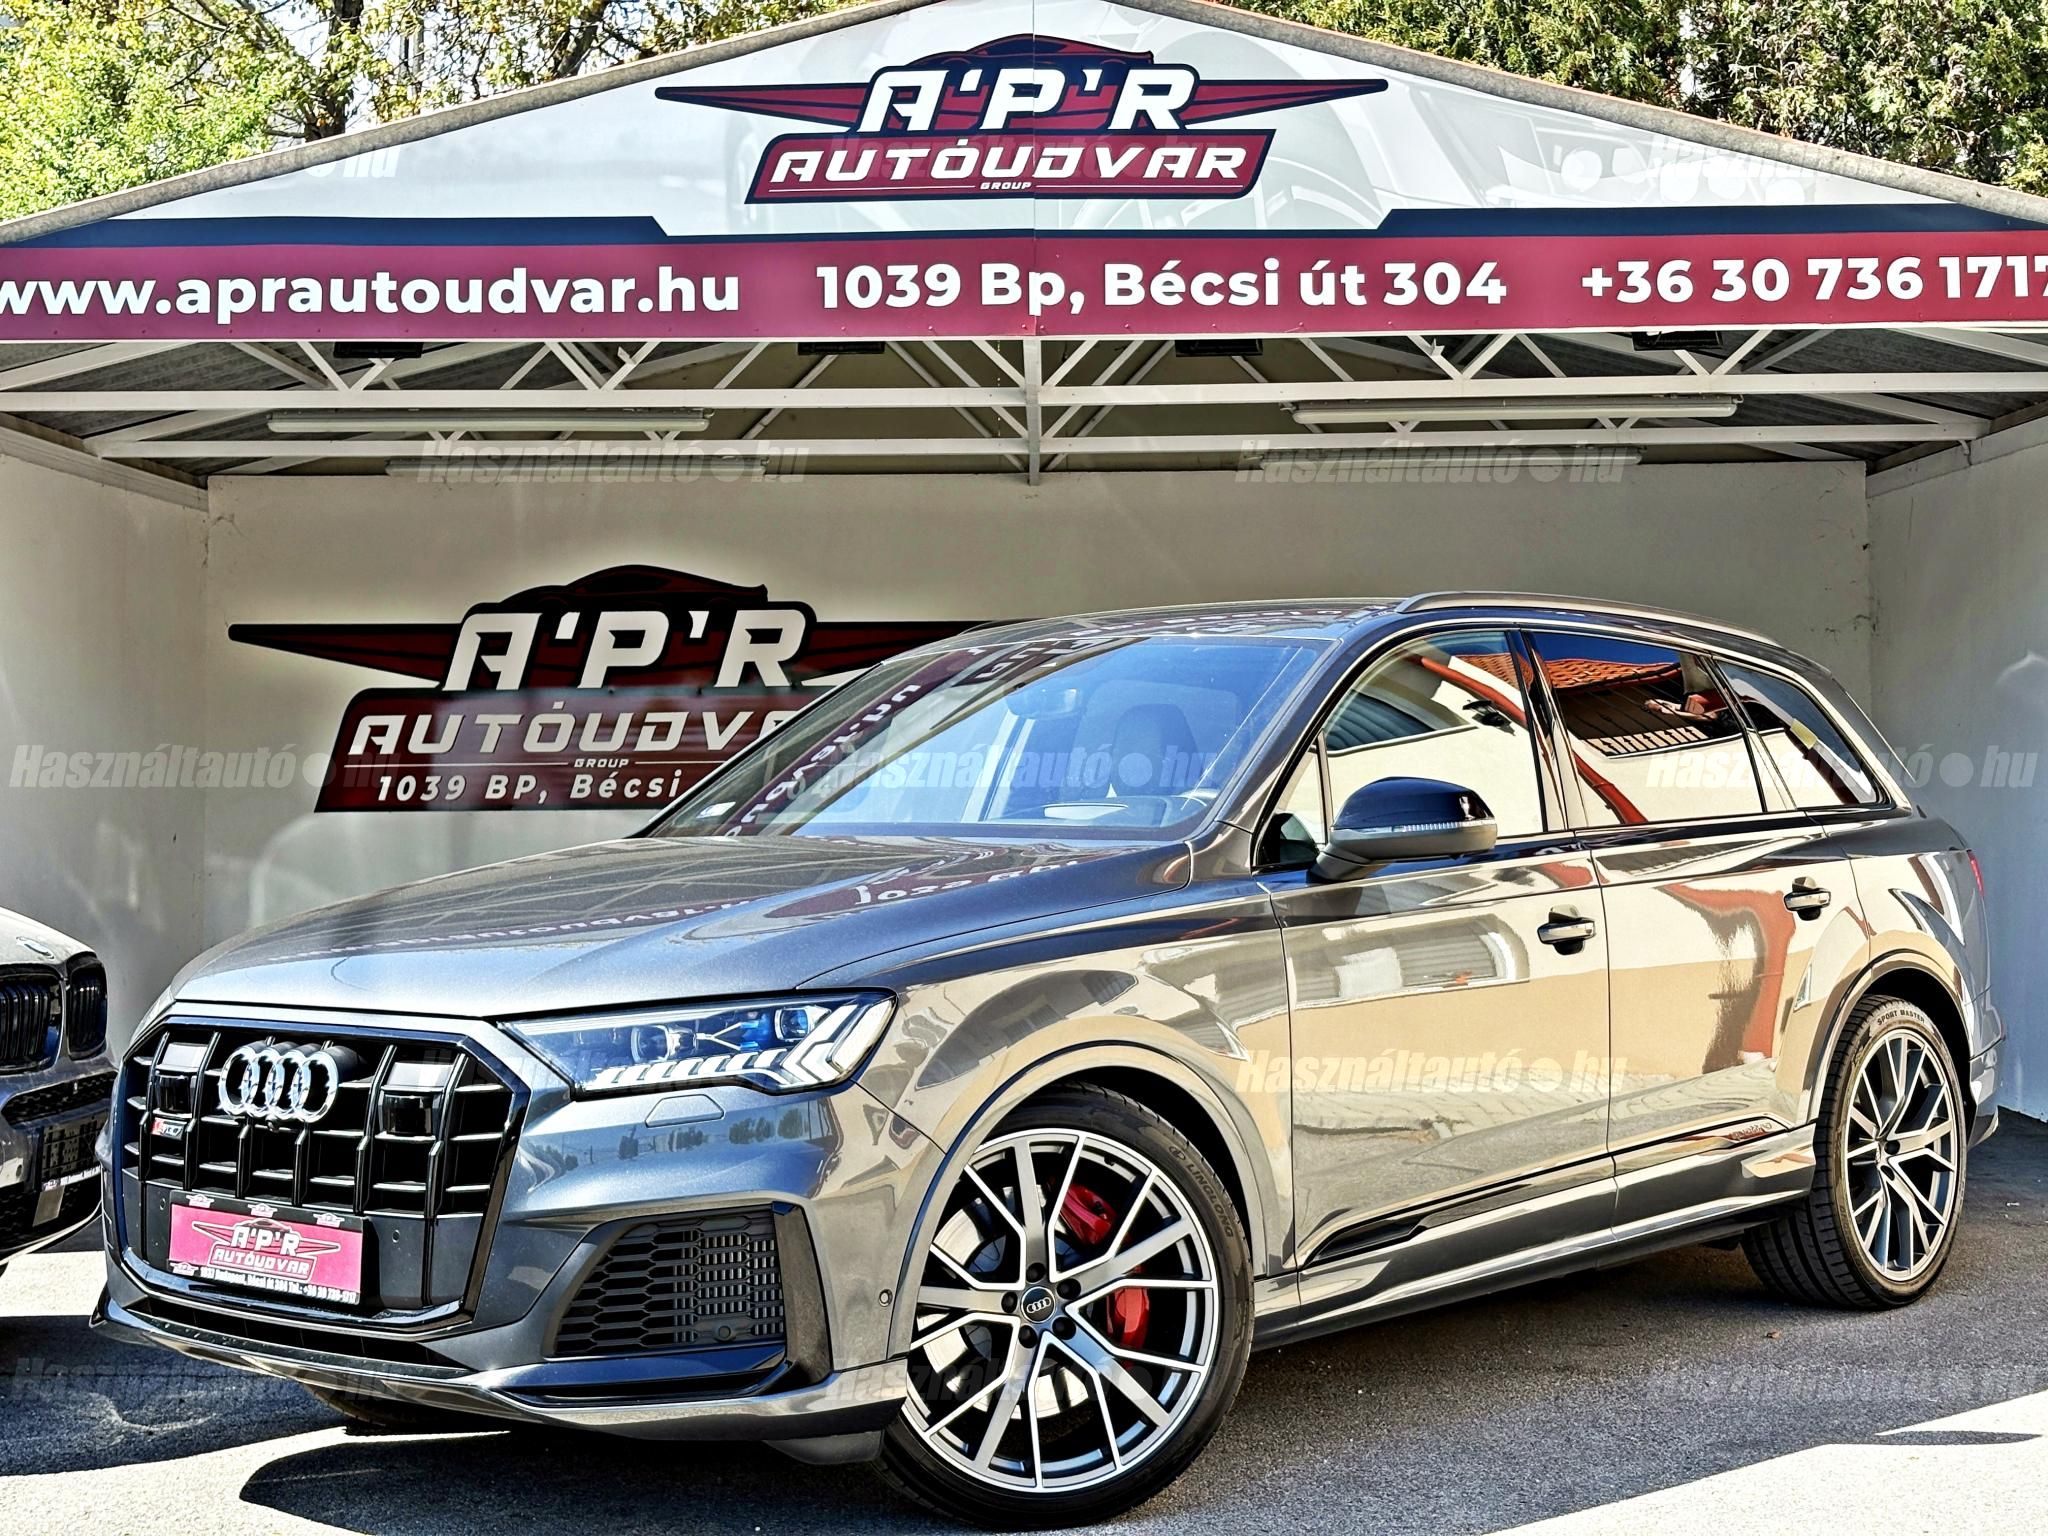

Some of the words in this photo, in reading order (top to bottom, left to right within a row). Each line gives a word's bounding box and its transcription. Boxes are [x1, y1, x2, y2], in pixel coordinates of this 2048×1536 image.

[769, 139, 1247, 183] AUTÓUDVAR
[979, 181, 1032, 190] GROUP
[0, 266, 739, 324] www.aprautoudvar.hu
[817, 264, 961, 310] 1039
[981, 263, 1085, 316] Bp,
[1105, 258, 1279, 307] Bécsi
[1300, 259, 1367, 306] út
[1383, 261, 1507, 305] 304
[1582, 259, 1694, 303] +36
[1712, 258, 1790, 302] 30
[1807, 257, 1921, 301] 736
[348, 701, 798, 756] AUTÓUDV
[574, 758, 629, 768] GROUP
[378, 775, 466, 803] 1039
[485, 774, 548, 804] BP,
[570, 769, 681, 800] Bécsi
[1877, 1010, 1898, 1026] SPORT
[1900, 1010, 1925, 1024] MASTER
[1187, 1163, 1234, 1238] LINGLONG
[213, 1248, 310, 1276] AUTÓUDVAR
